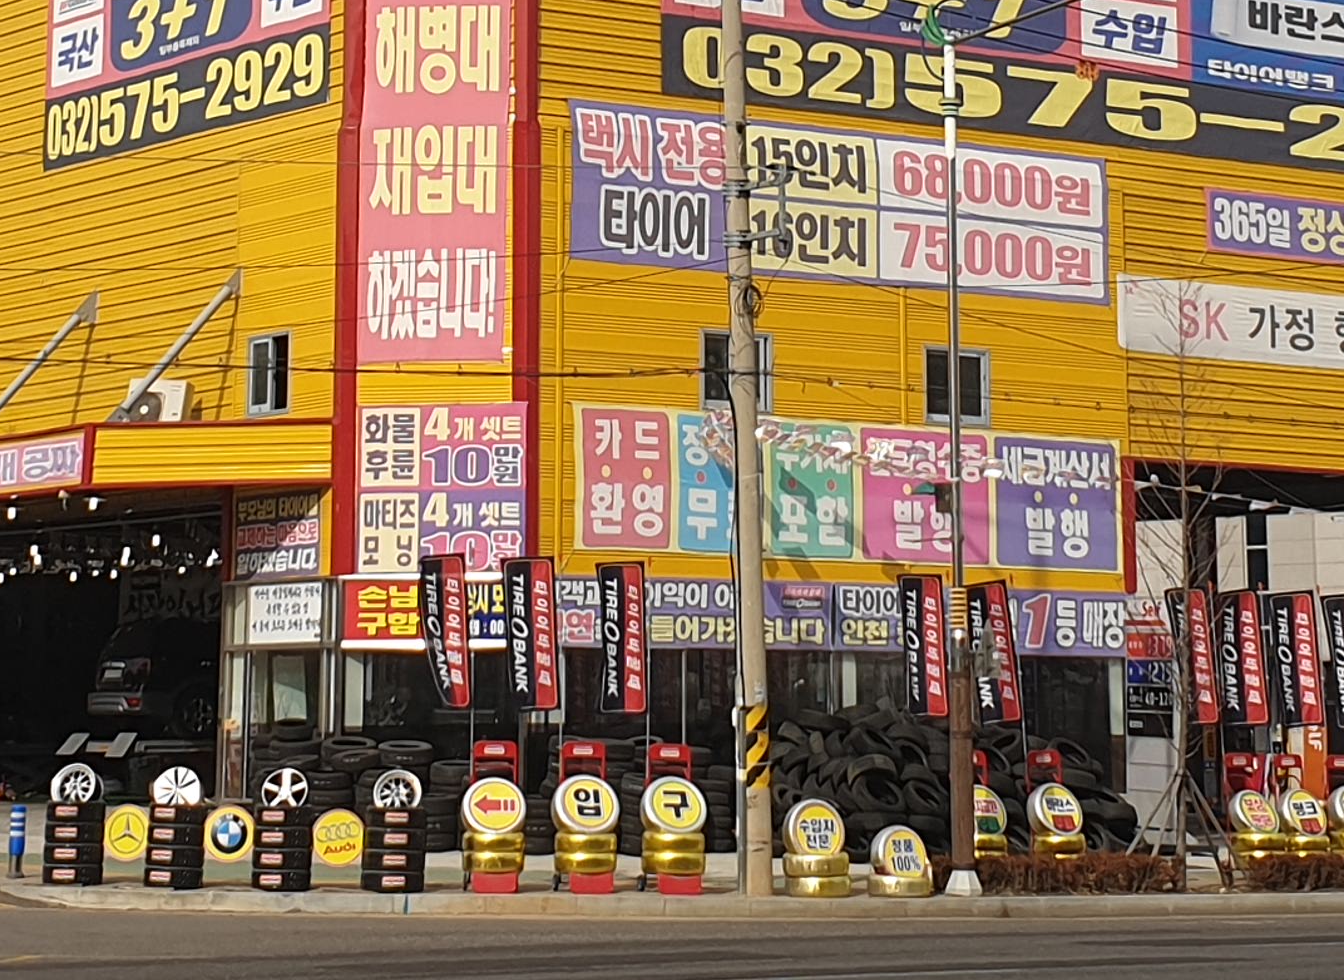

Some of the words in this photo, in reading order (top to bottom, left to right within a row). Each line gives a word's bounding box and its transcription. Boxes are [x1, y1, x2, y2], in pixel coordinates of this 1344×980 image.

[58, 26, 99, 72] 국산
[376, 5, 500, 95] 해병대
[1090, 6, 1167, 56] 수입
[46, 34, 325, 161] 032)575-2929
[1207, 58, 1334, 93] 타이어뱅크
[579, 110, 650, 177] 택시
[369, 123, 496, 219] 재입대
[605, 188, 706, 257] 타이어
[1213, 197, 1291, 249] 365일
[368, 247, 496, 340] 하겠습니다!
[1178, 299, 1229, 343] SK
[1248, 305, 1314, 351] 가정
[365, 413, 416, 446] 화물
[480, 416, 522, 442] 셋트
[595, 419, 660, 460] 카드
[22, 442, 80, 482] 공짜
[365, 499, 416, 530] 마티즈
[478, 502, 520, 527] 셋트
[590, 482, 664, 538] 환영
[1025, 507, 1089, 558] 발행
[357, 584, 419, 610] 손님
[357, 611, 420, 637] 구함
[1083, 600, 1126, 649] 매장
[323, 842, 356, 856] Audi
